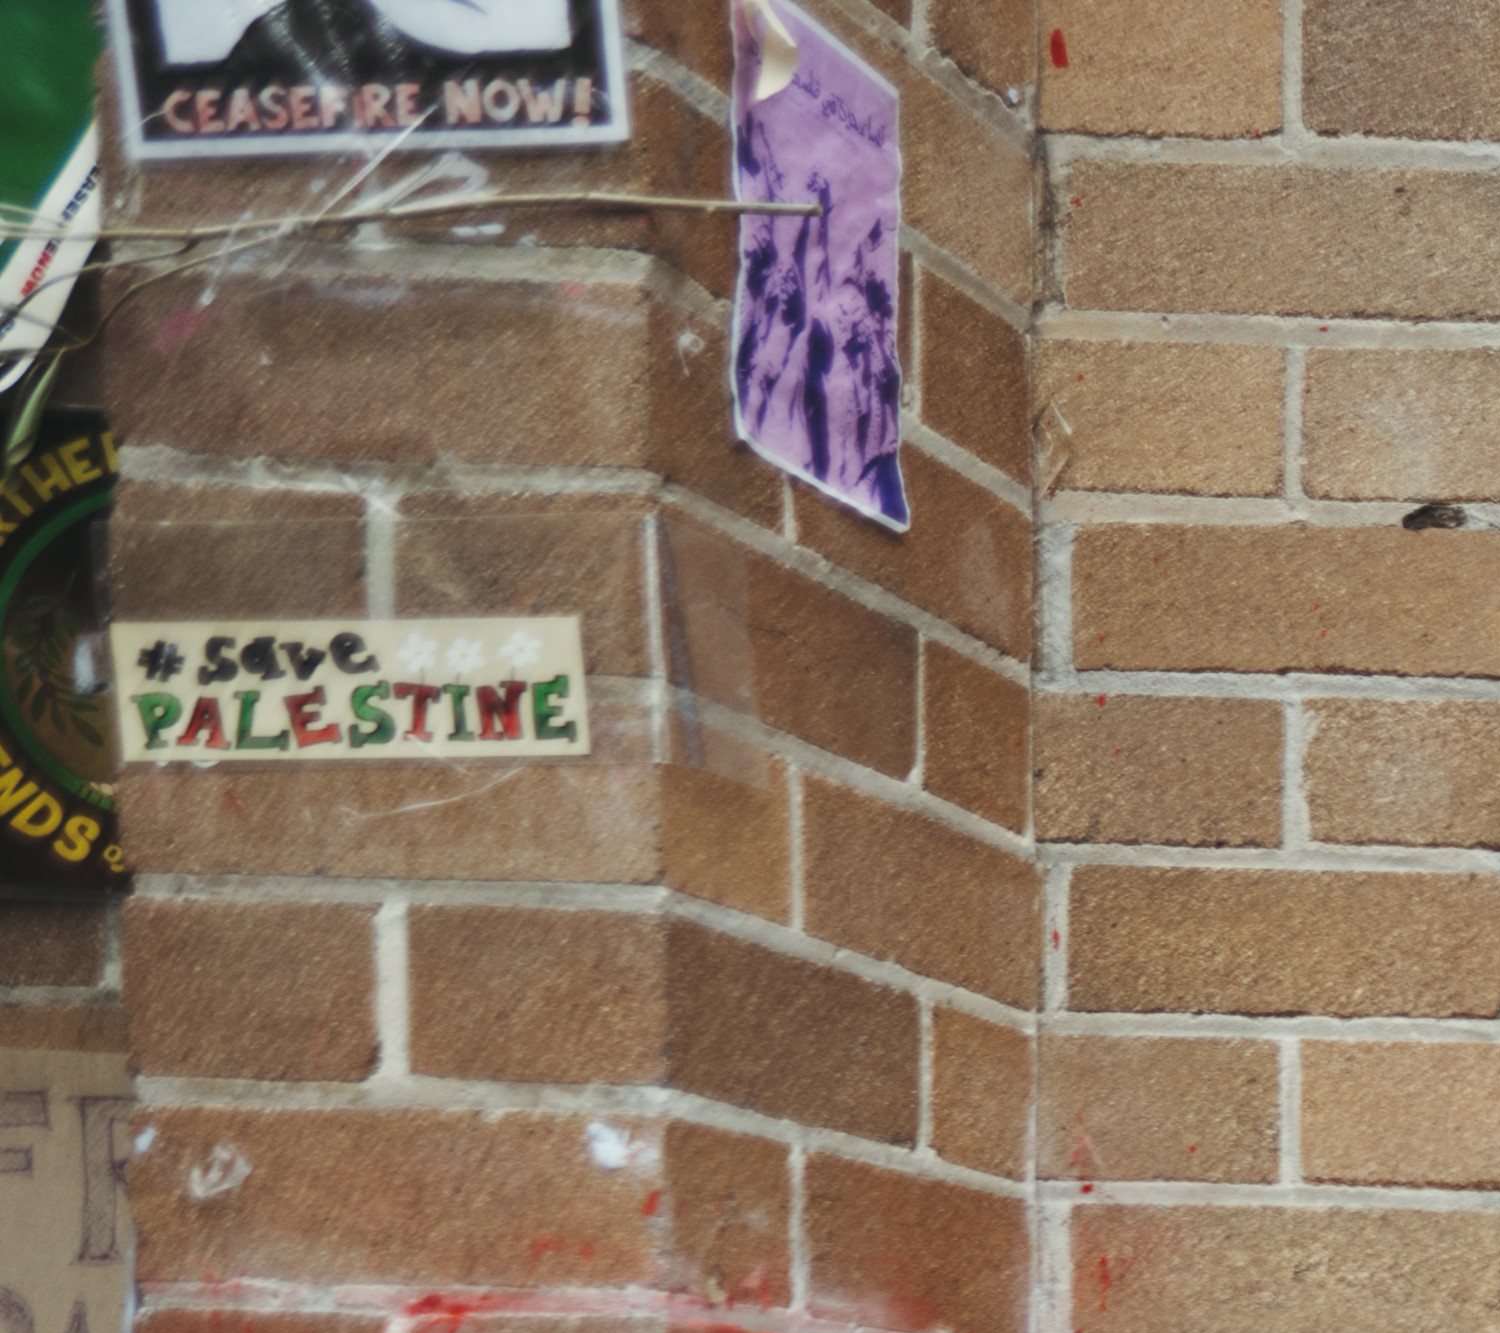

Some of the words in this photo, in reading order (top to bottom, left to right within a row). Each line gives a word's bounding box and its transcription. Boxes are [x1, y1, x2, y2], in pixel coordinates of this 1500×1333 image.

[162, 80, 424, 135] CEASEFIRE
[443, 76, 593, 129] NOW!
[130, 674, 578, 751] PALESTINE
